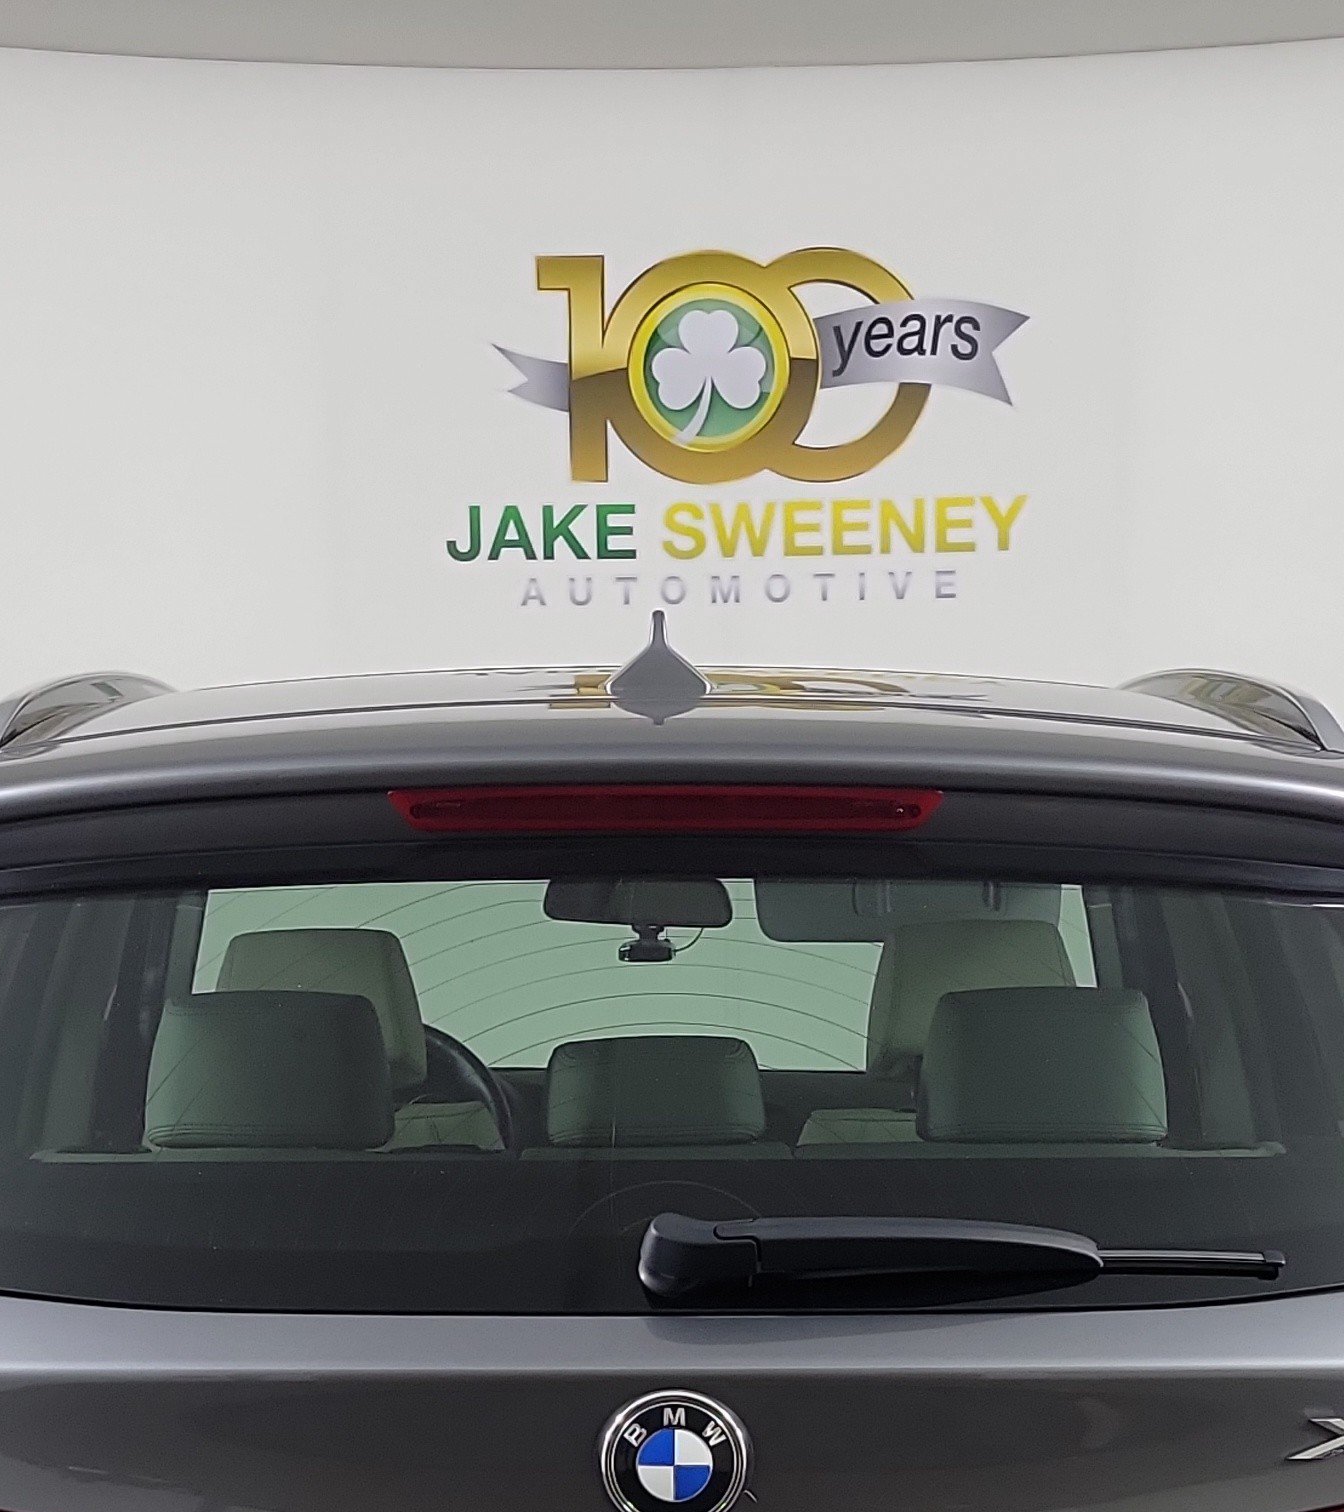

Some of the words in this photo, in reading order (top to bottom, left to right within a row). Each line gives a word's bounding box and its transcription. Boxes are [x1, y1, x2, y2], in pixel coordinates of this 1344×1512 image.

[535, 246, 932, 485] 100
[832, 313, 982, 377] years
[446, 503, 637, 562] JAKE
[661, 494, 1029, 561] SWEENEY
[520, 570, 958, 608] AUTOMOTIVE
[624, 1406, 727, 1447] BMW
